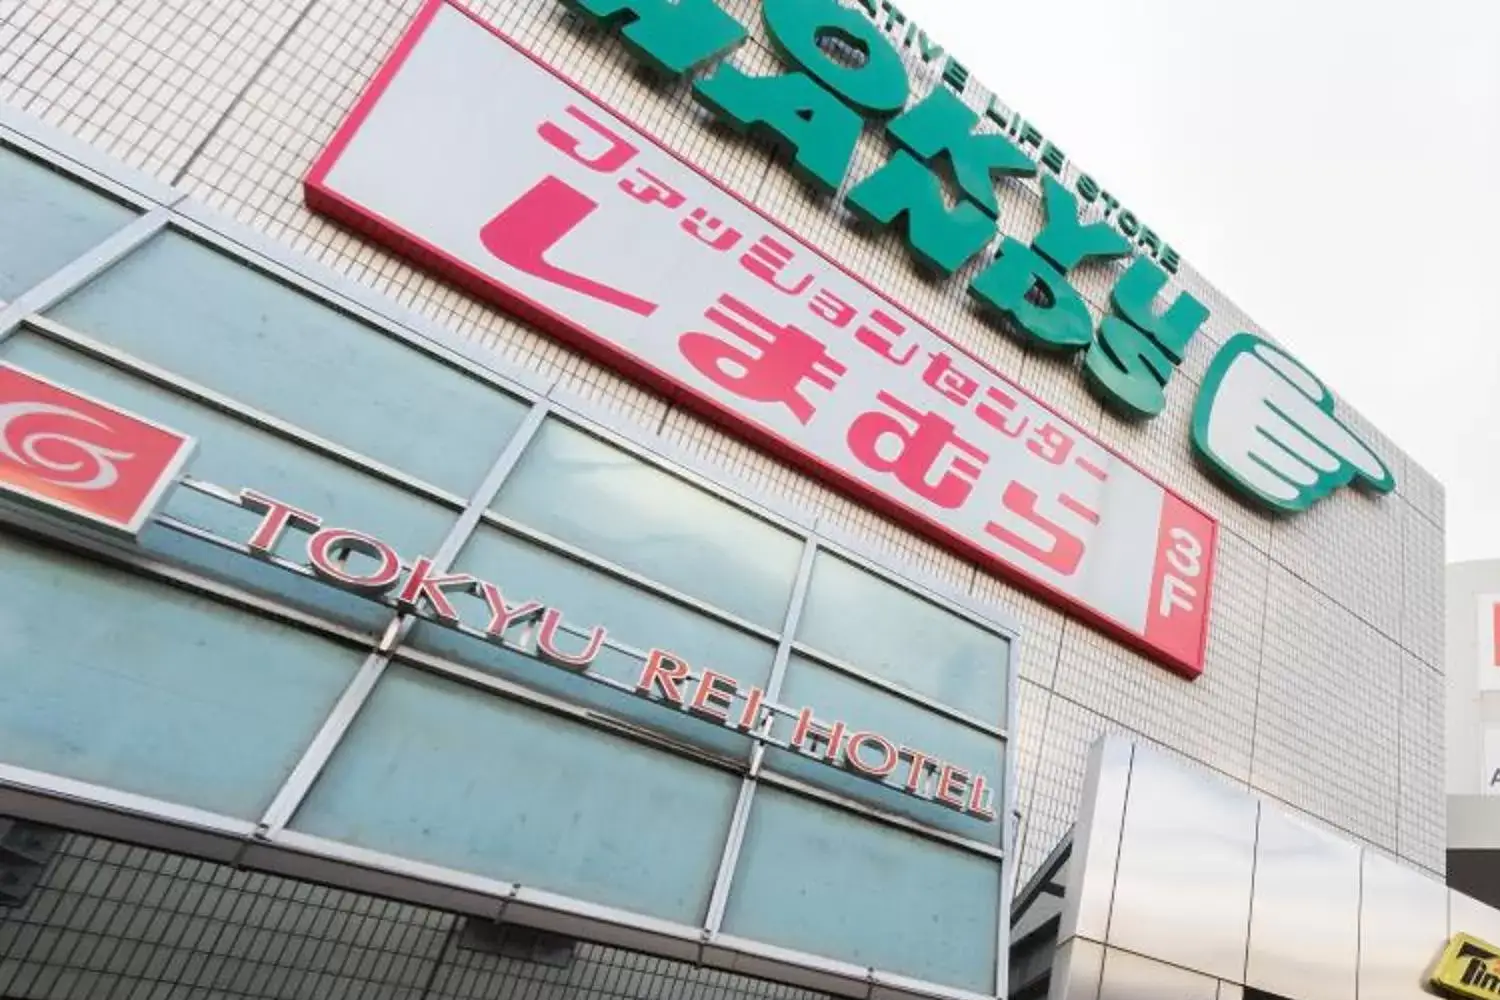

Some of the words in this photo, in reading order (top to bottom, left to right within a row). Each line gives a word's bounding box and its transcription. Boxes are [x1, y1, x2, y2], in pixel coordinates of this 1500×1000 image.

[537, 105, 1108, 481] ファッションセンター
[985, 93, 1065, 175] LIFE
[1076, 173, 1180, 276] STORE
[480, 175, 1100, 576] しまむら
[240, 488, 607, 670] TOKYU
[636, 648, 767, 732] REI
[790, 706, 998, 821] HOTEL
